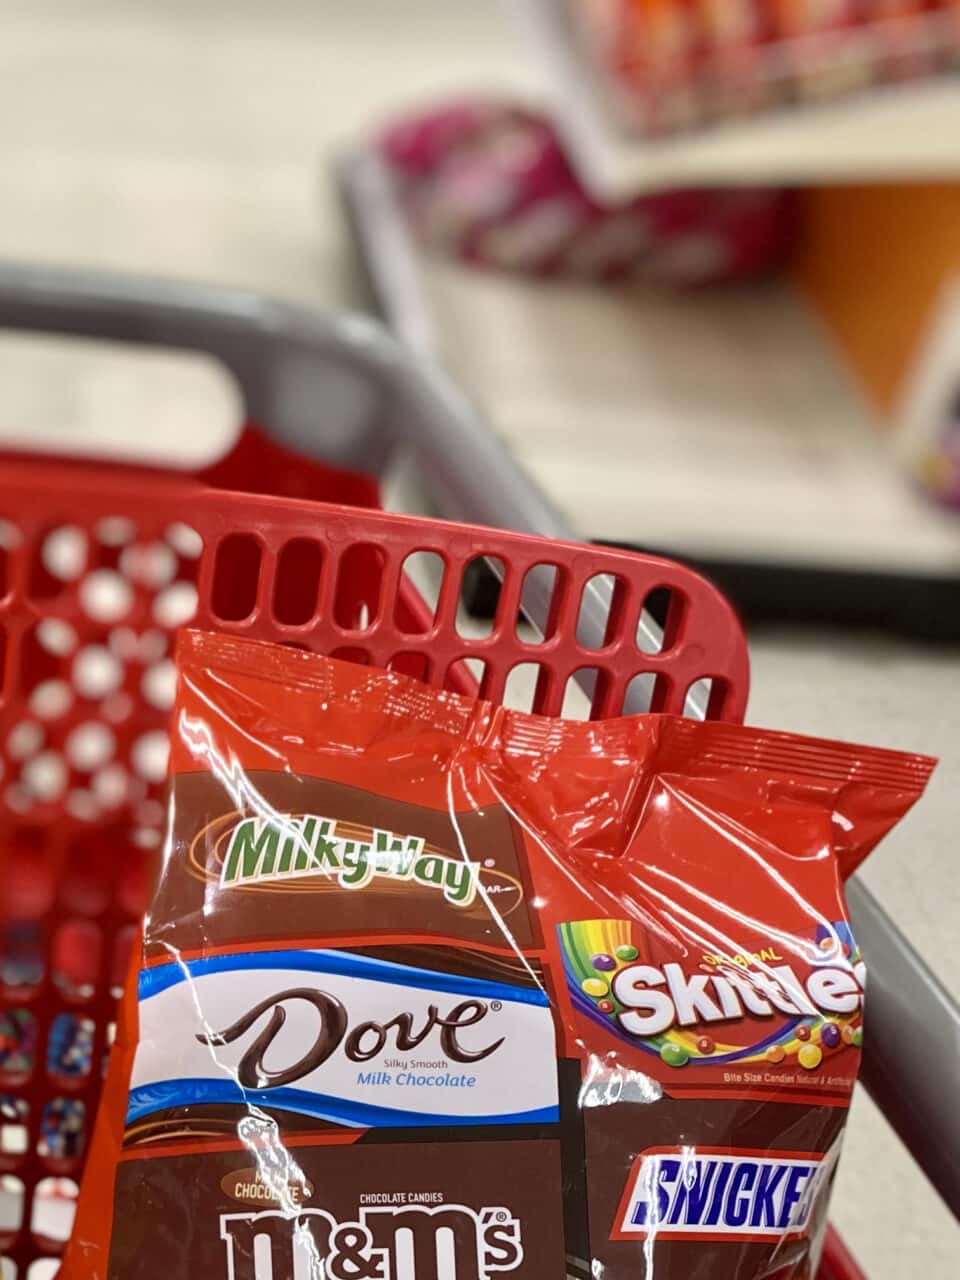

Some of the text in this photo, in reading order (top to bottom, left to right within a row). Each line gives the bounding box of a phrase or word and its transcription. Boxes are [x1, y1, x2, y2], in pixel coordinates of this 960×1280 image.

[220, 815, 374, 889] Milky
[194, 987, 507, 1090] Dove
[356, 1071, 477, 1088] Milk Chocolate
[383, 1058, 448, 1070] Silky Smooth
[359, 1191, 444, 1205] CHOCOLATE CANDIES
[631, 1159, 818, 1229] SNICKE
